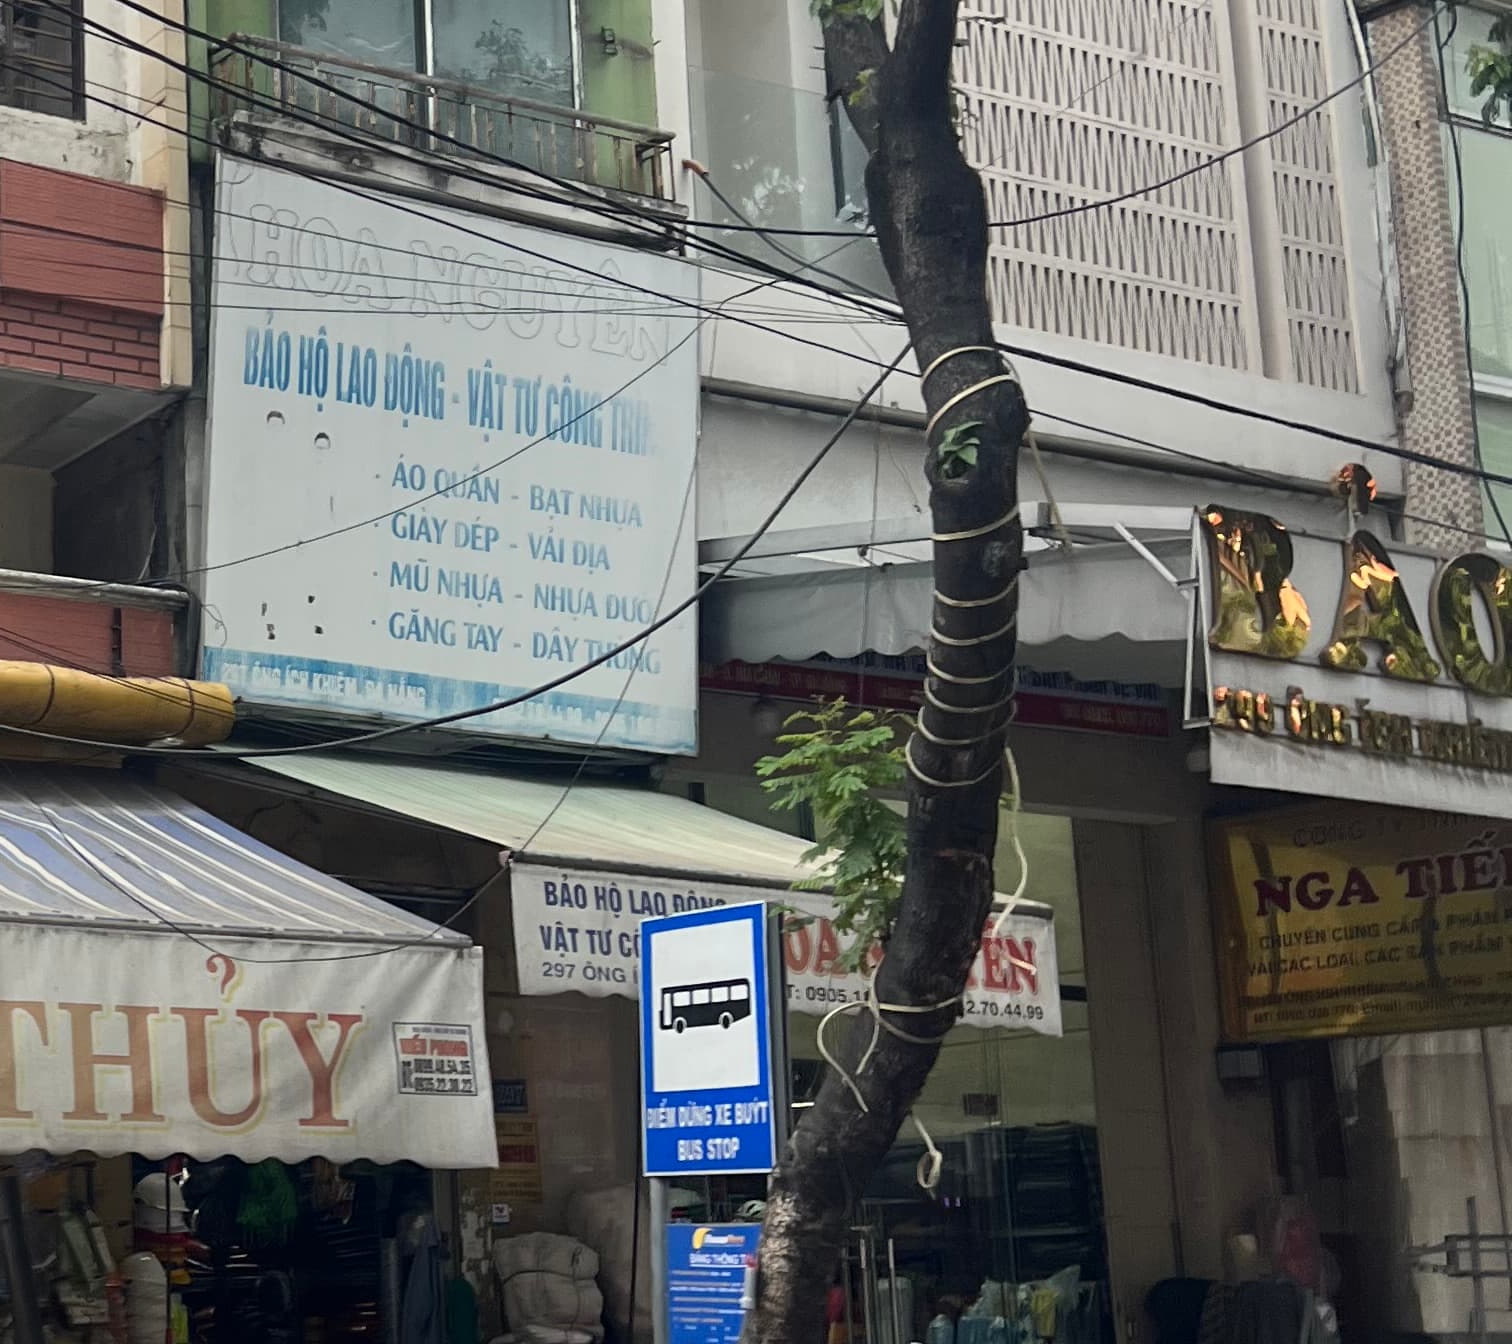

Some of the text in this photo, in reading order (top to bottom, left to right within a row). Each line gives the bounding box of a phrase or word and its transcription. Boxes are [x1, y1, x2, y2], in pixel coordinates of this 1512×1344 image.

[244, 311, 291, 392] BẢO
[298, 325, 329, 413] HỘ
[336, 342, 377, 407] LAO
[384, 342, 445, 428] ĐỘNG
[468, 359, 507, 442] VẬT
[513, 374, 541, 437] TƯ
[545, 373, 603, 448] CÔNG
[392, 454, 426, 491] ÁO
[530, 484, 574, 520] BẠT
[454, 516, 500, 552] DÉP
[438, 568, 503, 608] NHỰA
[463, 622, 503, 653] TAY
[533, 625, 579, 663] DÂY
[1254, 831, 1512, 916] NGA TIẾ
[544, 874, 588, 909] BẢO
[594, 882, 622, 918] HỘ
[628, 889, 667, 916] LAO
[539, 921, 580, 957] VẬT
[586, 929, 613, 956] TƯ
[542, 959, 627, 983] 297 ÔNG
[714, 1103, 733, 1125] XE
[677, 1136, 741, 1161] BUS STOP
